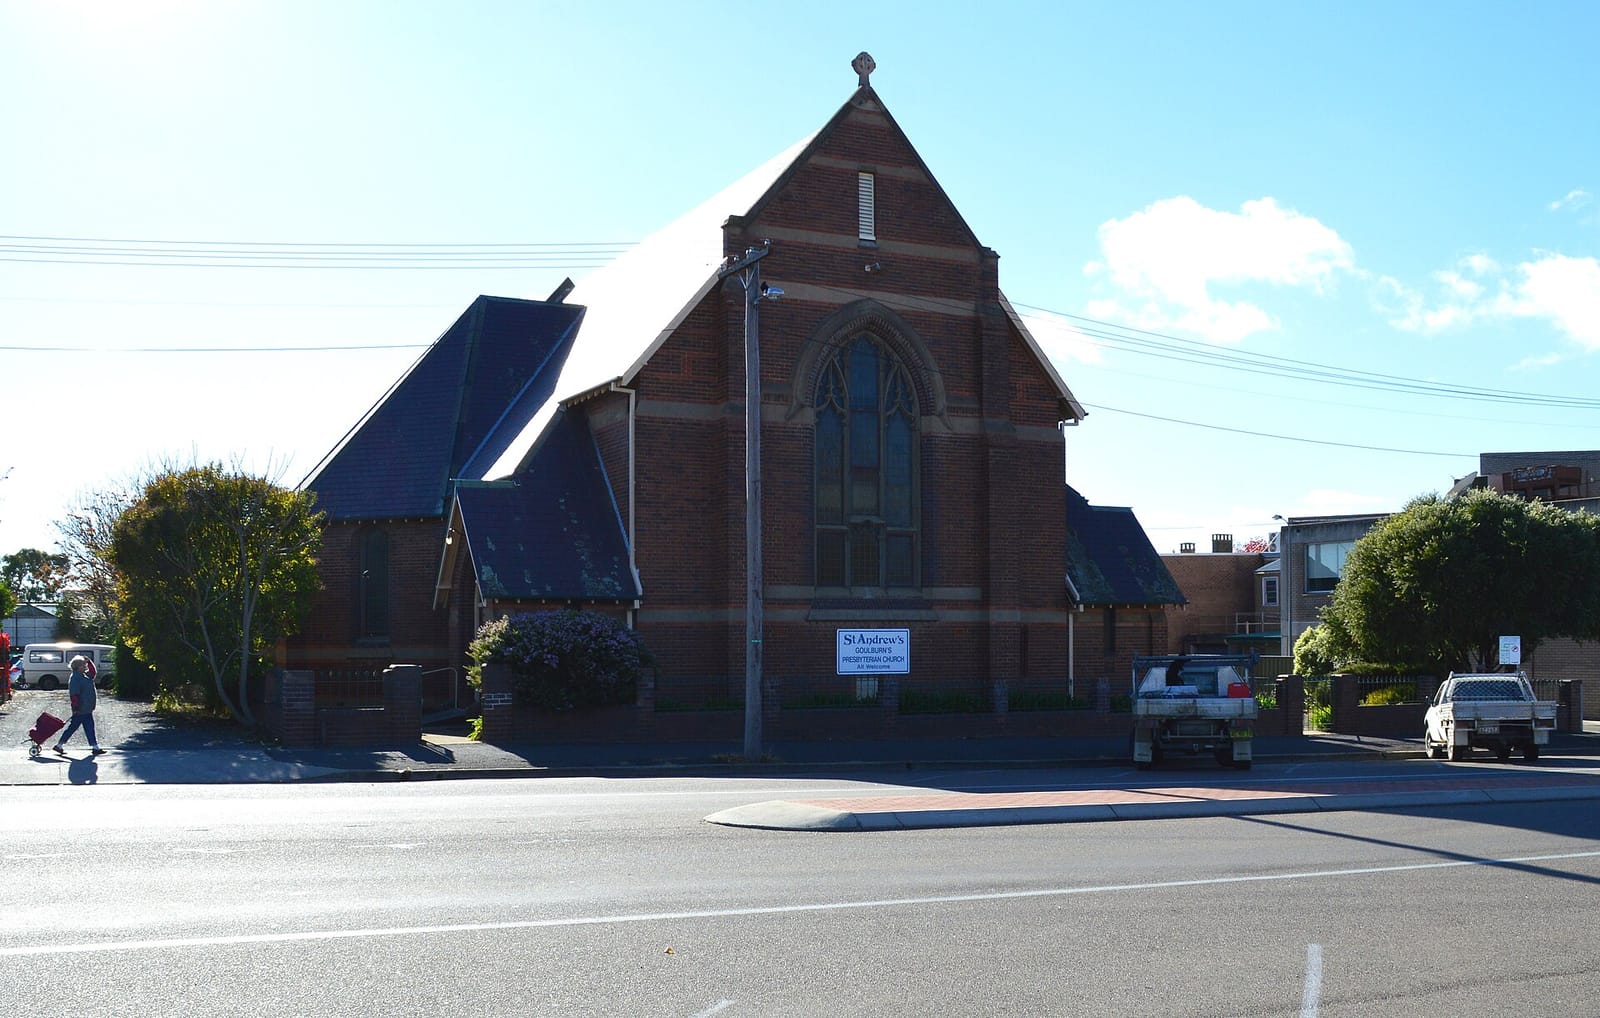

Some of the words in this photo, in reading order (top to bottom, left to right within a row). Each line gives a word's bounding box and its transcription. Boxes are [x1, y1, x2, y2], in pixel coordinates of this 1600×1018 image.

[844, 634, 856, 645] St
[857, 633, 904, 646] Andrew's
[883, 655, 904, 663] CHURCH
